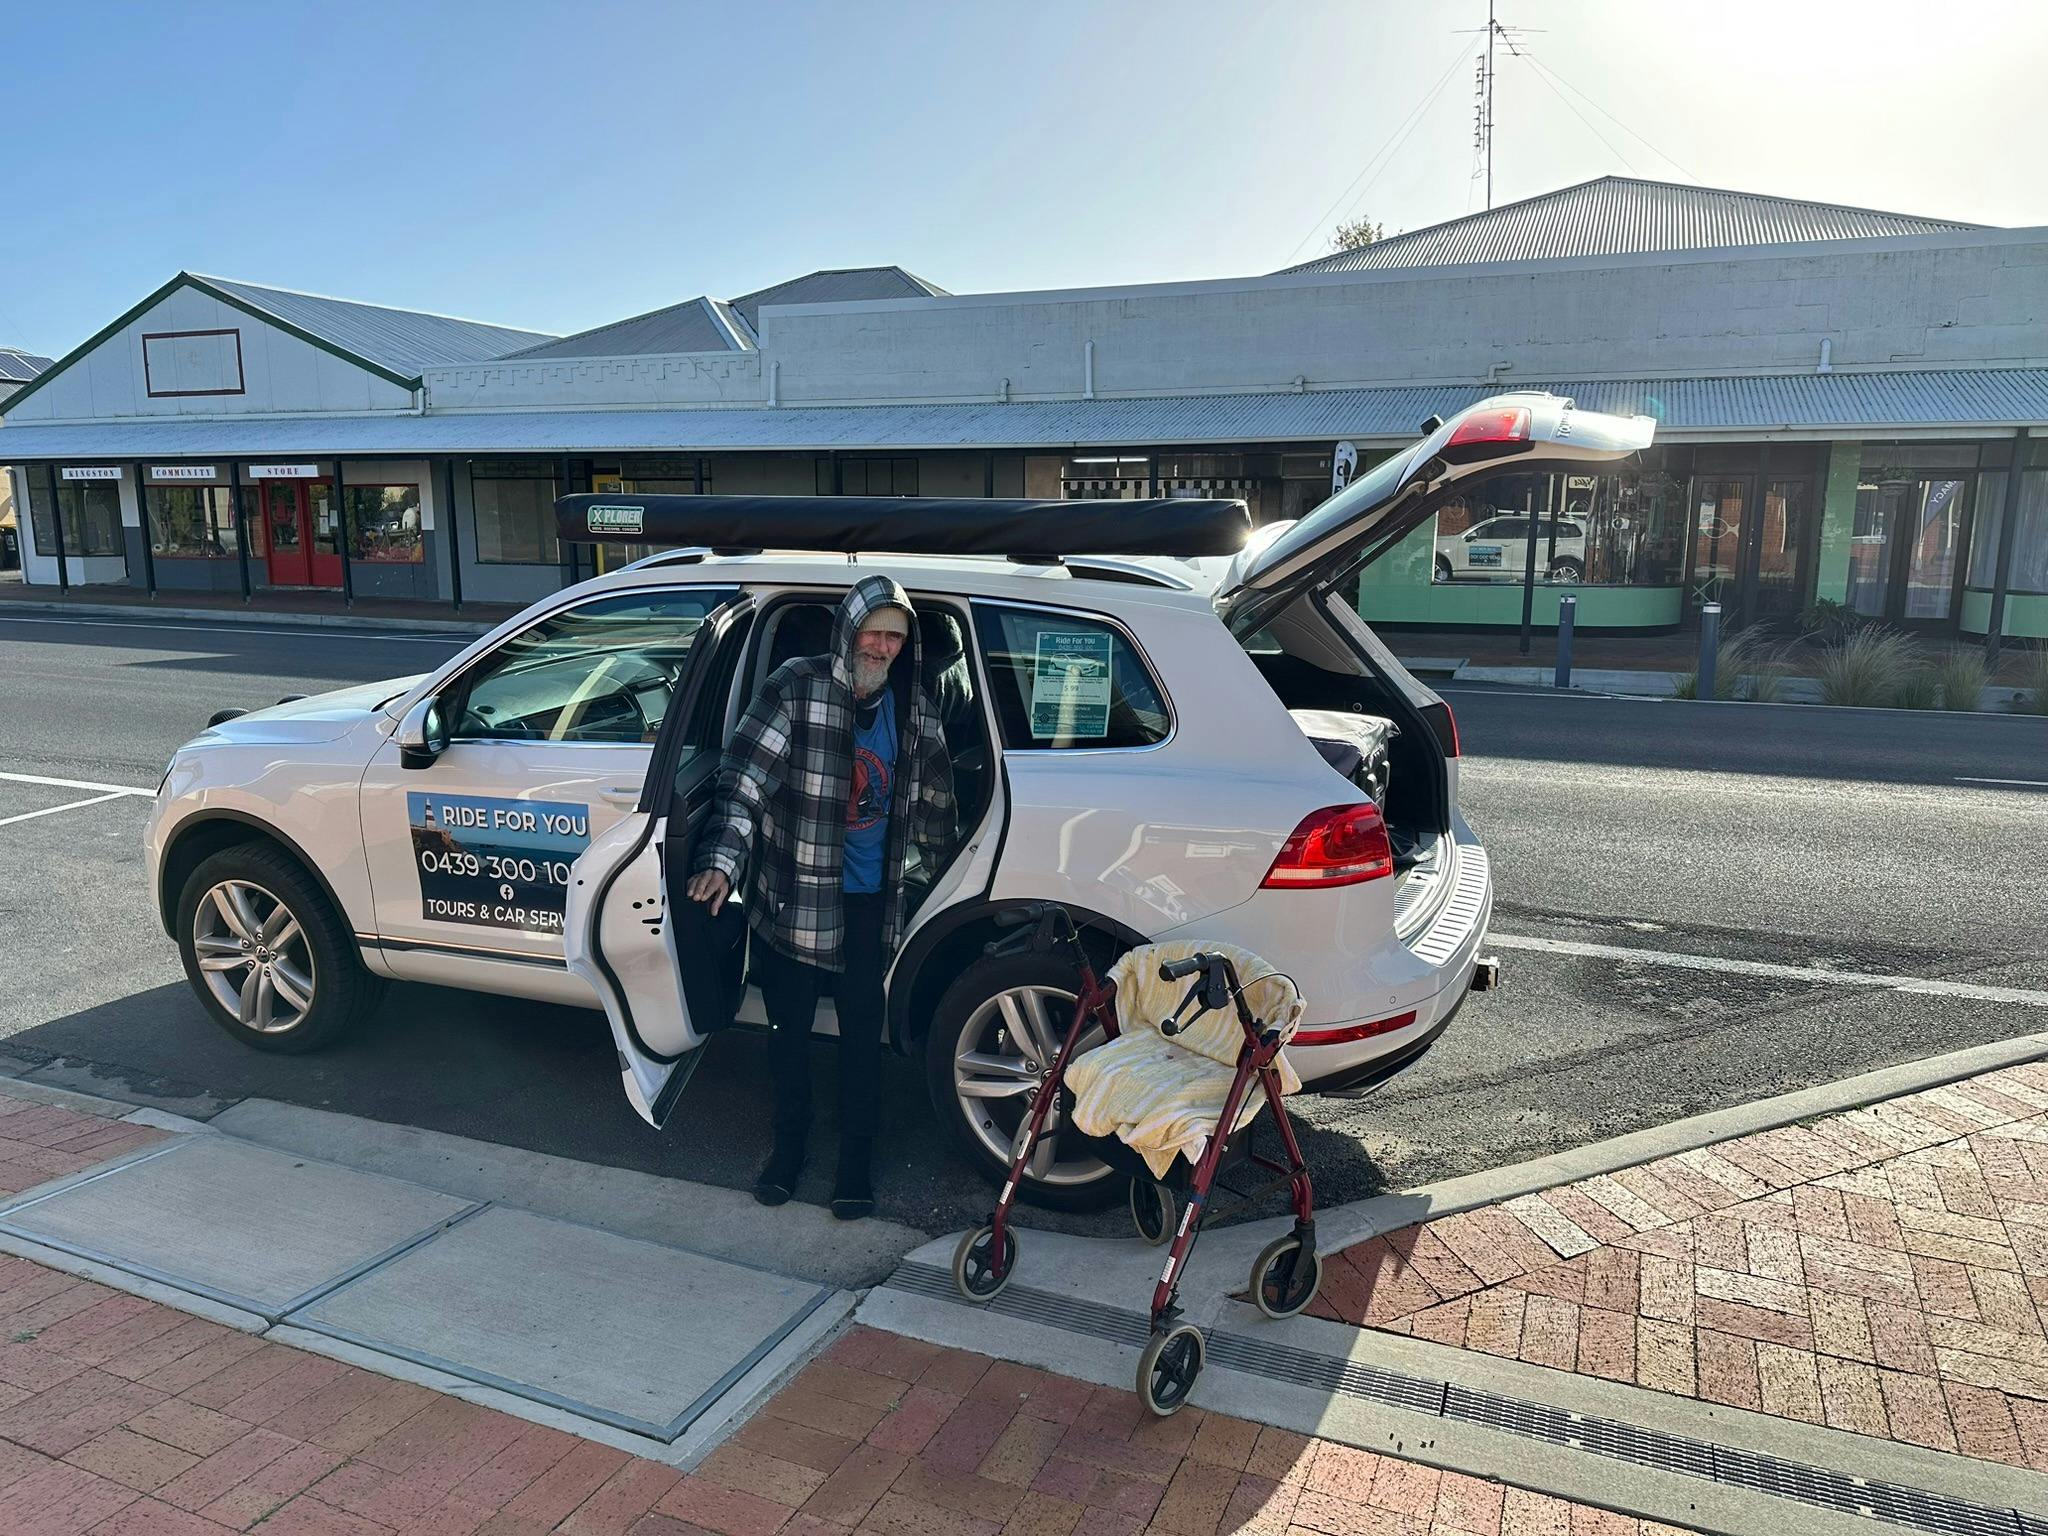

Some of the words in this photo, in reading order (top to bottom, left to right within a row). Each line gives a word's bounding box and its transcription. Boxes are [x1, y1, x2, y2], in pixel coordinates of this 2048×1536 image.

[68, 469, 114, 478] KINGSTON
[156, 468, 211, 476] COMMUNITY
[267, 467, 300, 475] STORE
[442, 805, 489, 828] RIDE
[493, 809, 537, 832] FOR
[541, 813, 587, 836] YOU
[421, 850, 480, 877] 0439
[485, 855, 537, 882] 300
[542, 861, 570, 886] 10
[427, 899, 476, 918] TOURS
[479, 904, 490, 919] &
[494, 906, 525, 923] CAR
[530, 909, 565, 928] SERV
